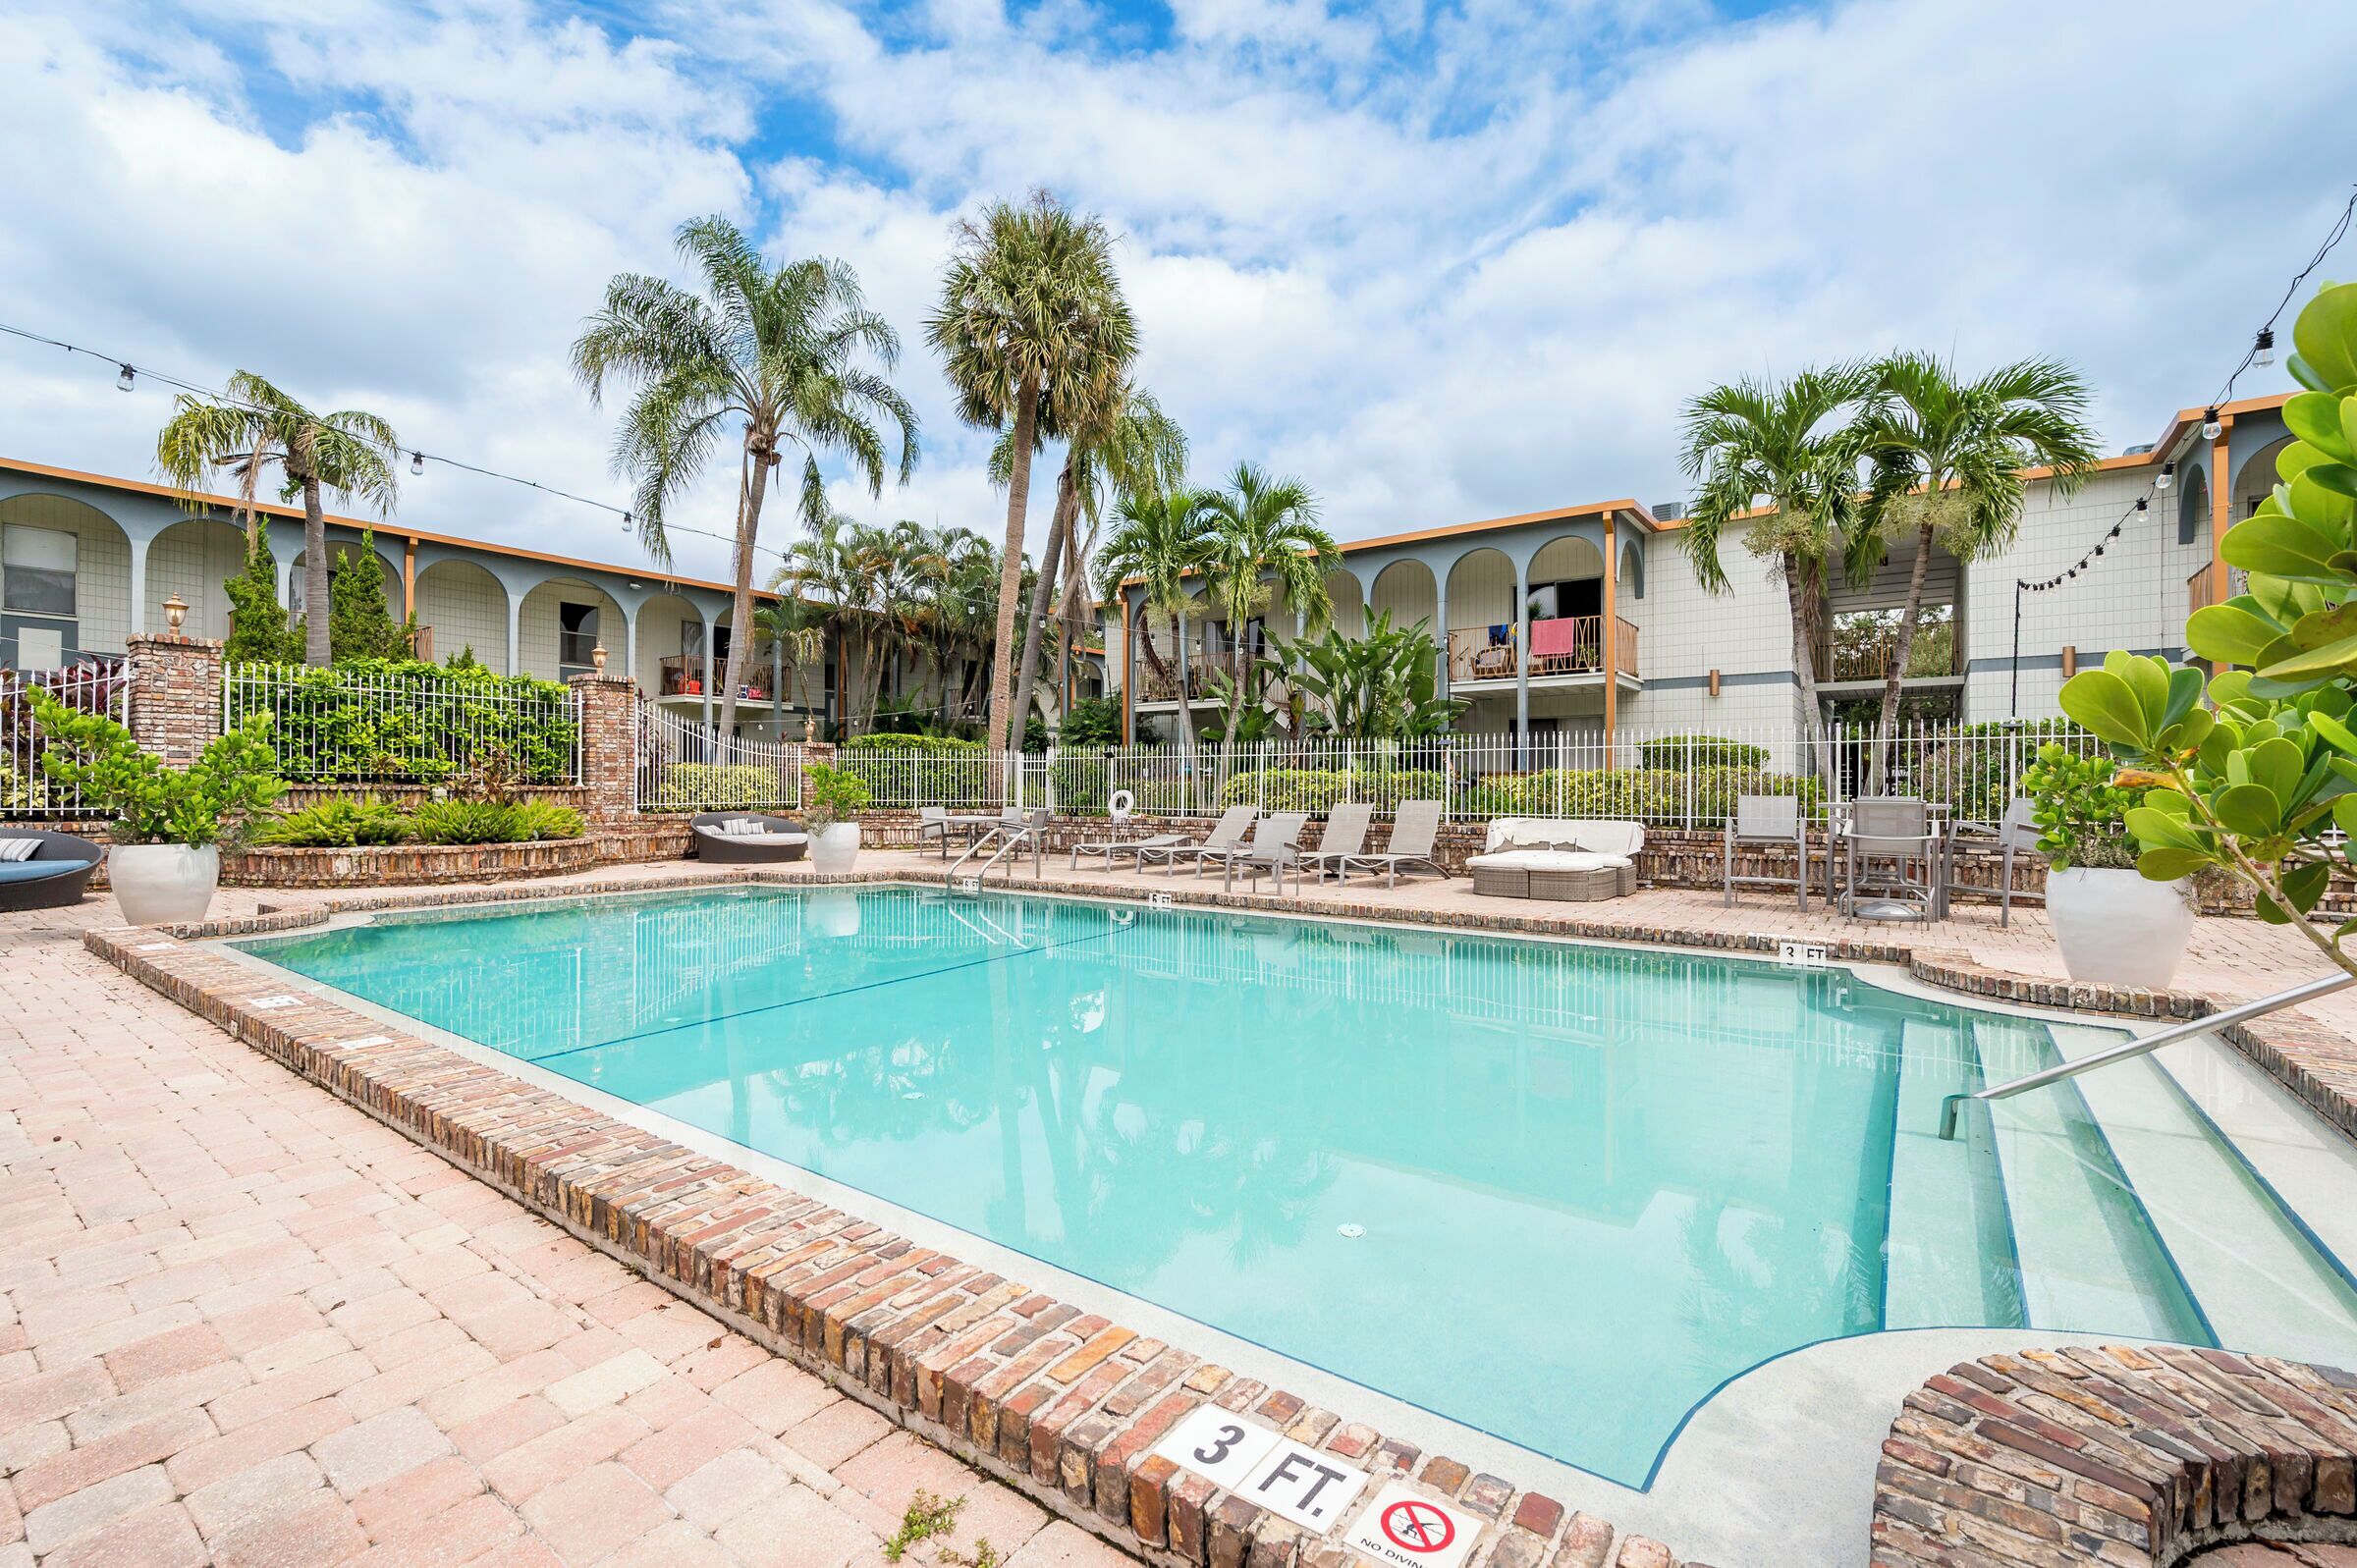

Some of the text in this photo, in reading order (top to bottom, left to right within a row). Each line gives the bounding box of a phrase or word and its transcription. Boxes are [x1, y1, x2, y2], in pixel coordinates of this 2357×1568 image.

[1786, 946, 1824, 959] 3 FT
[1193, 1425, 1346, 1517] 3 FT.
[1360, 1538, 1426, 1568] NO DIVIN
